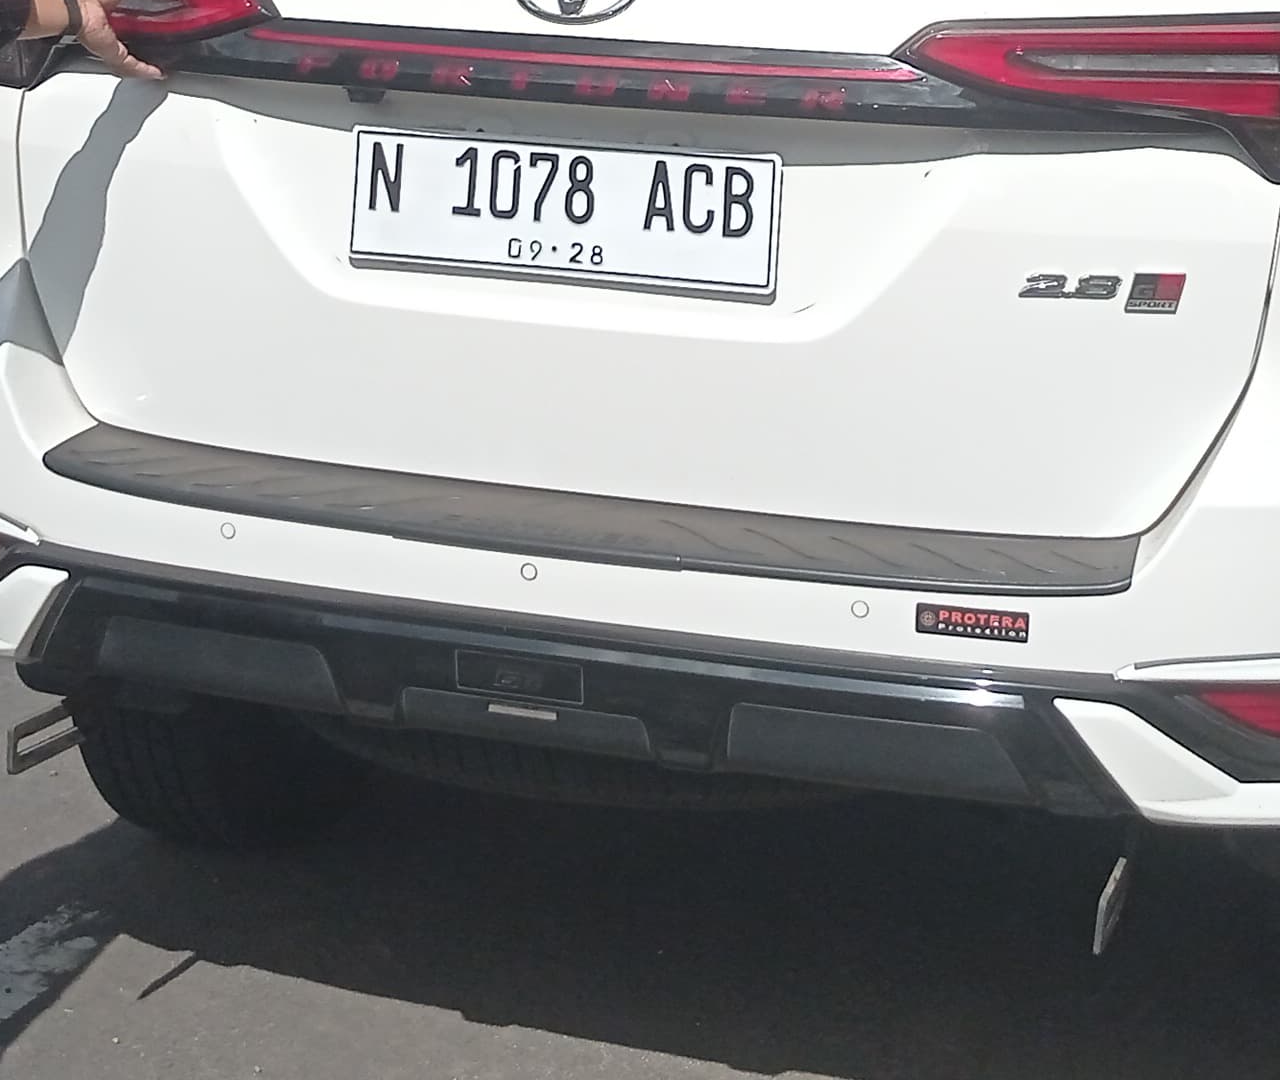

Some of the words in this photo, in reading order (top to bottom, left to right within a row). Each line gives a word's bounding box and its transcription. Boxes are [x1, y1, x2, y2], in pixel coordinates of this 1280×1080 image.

[368, 141, 405, 213] N
[451, 146, 596, 225] 1078
[642, 160, 755, 239] ACB
[1018, 273, 1122, 299] 2.8
[1128, 299, 1176, 309] SPORT
[938, 609, 1027, 630] PROTERA
